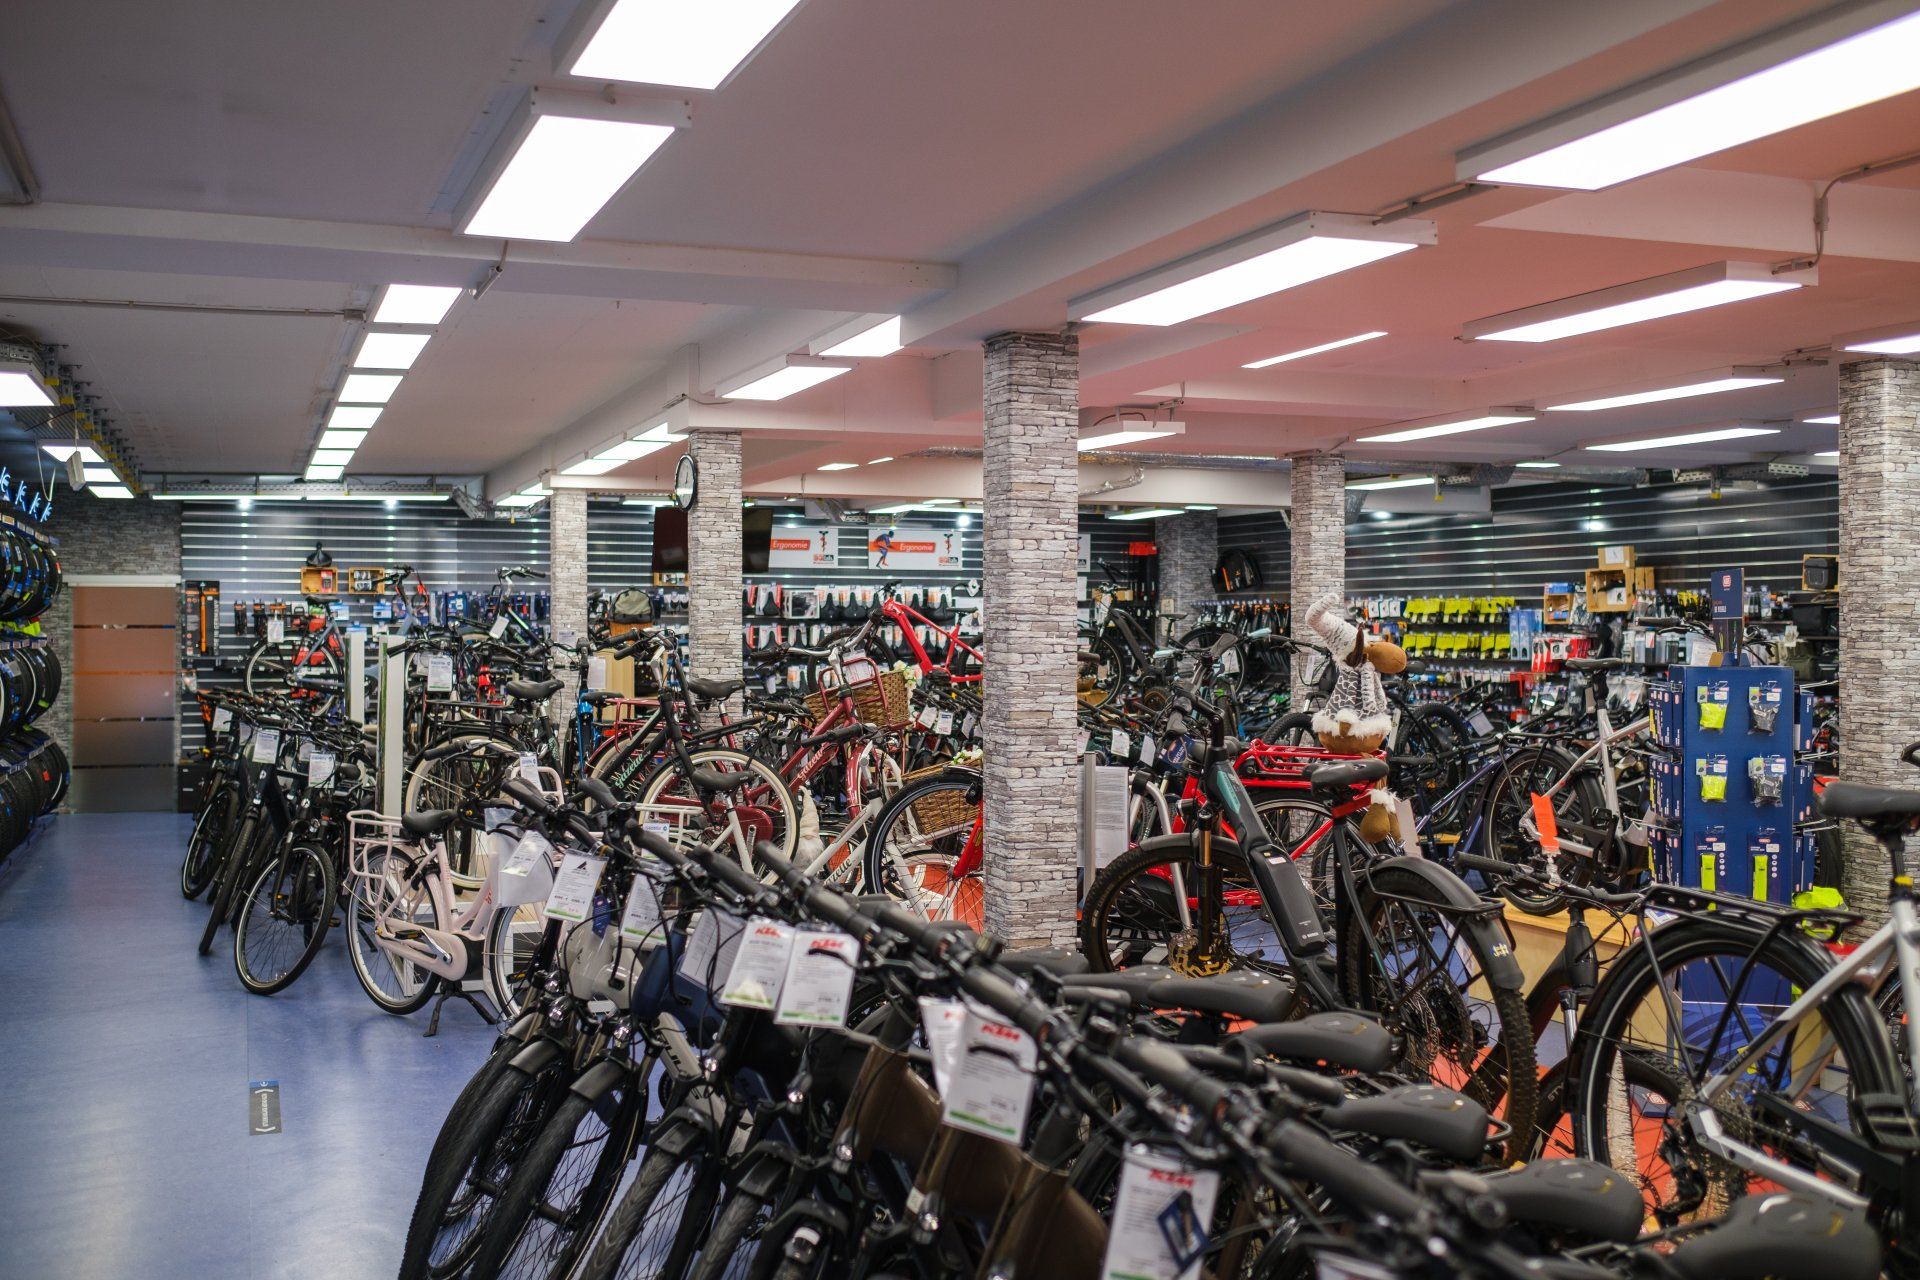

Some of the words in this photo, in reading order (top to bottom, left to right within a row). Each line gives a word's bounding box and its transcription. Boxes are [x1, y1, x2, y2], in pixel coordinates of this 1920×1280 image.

[773, 540, 807, 551] Ergonomie
[901, 543, 934, 553] Ergonomie
[810, 938, 845, 950] KTM
[981, 1023, 1021, 1042] KTM
